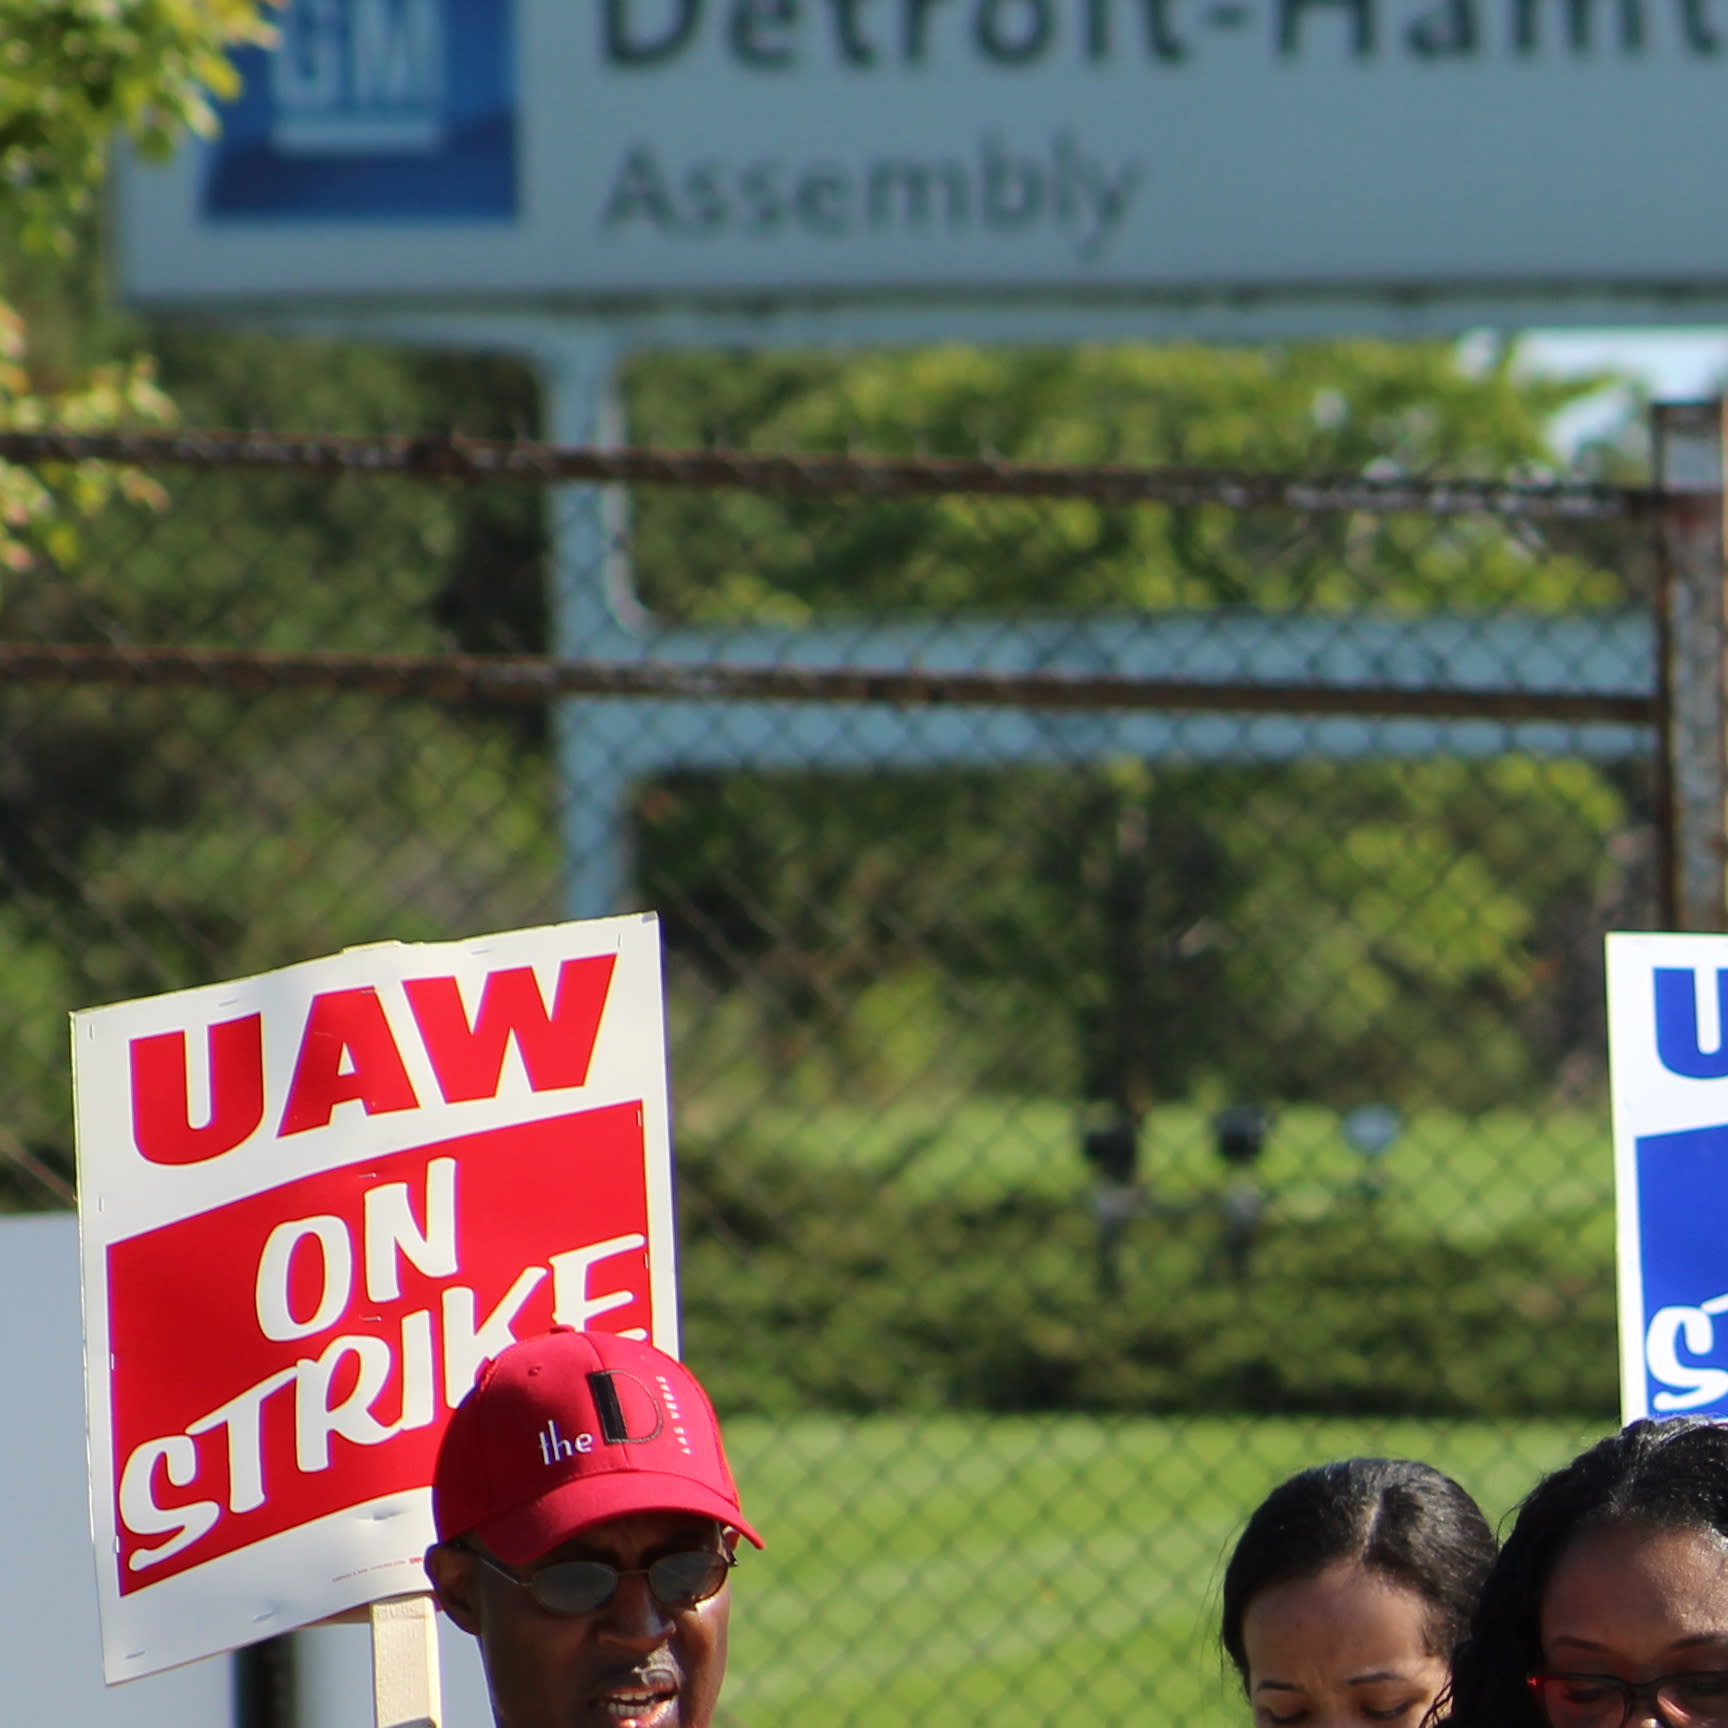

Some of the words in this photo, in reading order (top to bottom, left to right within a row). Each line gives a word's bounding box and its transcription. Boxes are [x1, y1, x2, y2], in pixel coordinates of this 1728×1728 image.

[600, 130, 1146, 258] Assembly
[129, 953, 617, 1165] UAW
[257, 1157, 458, 1342] ON
[118, 1234, 645, 1572] STRIKE
[539, 1419, 593, 1465] the
